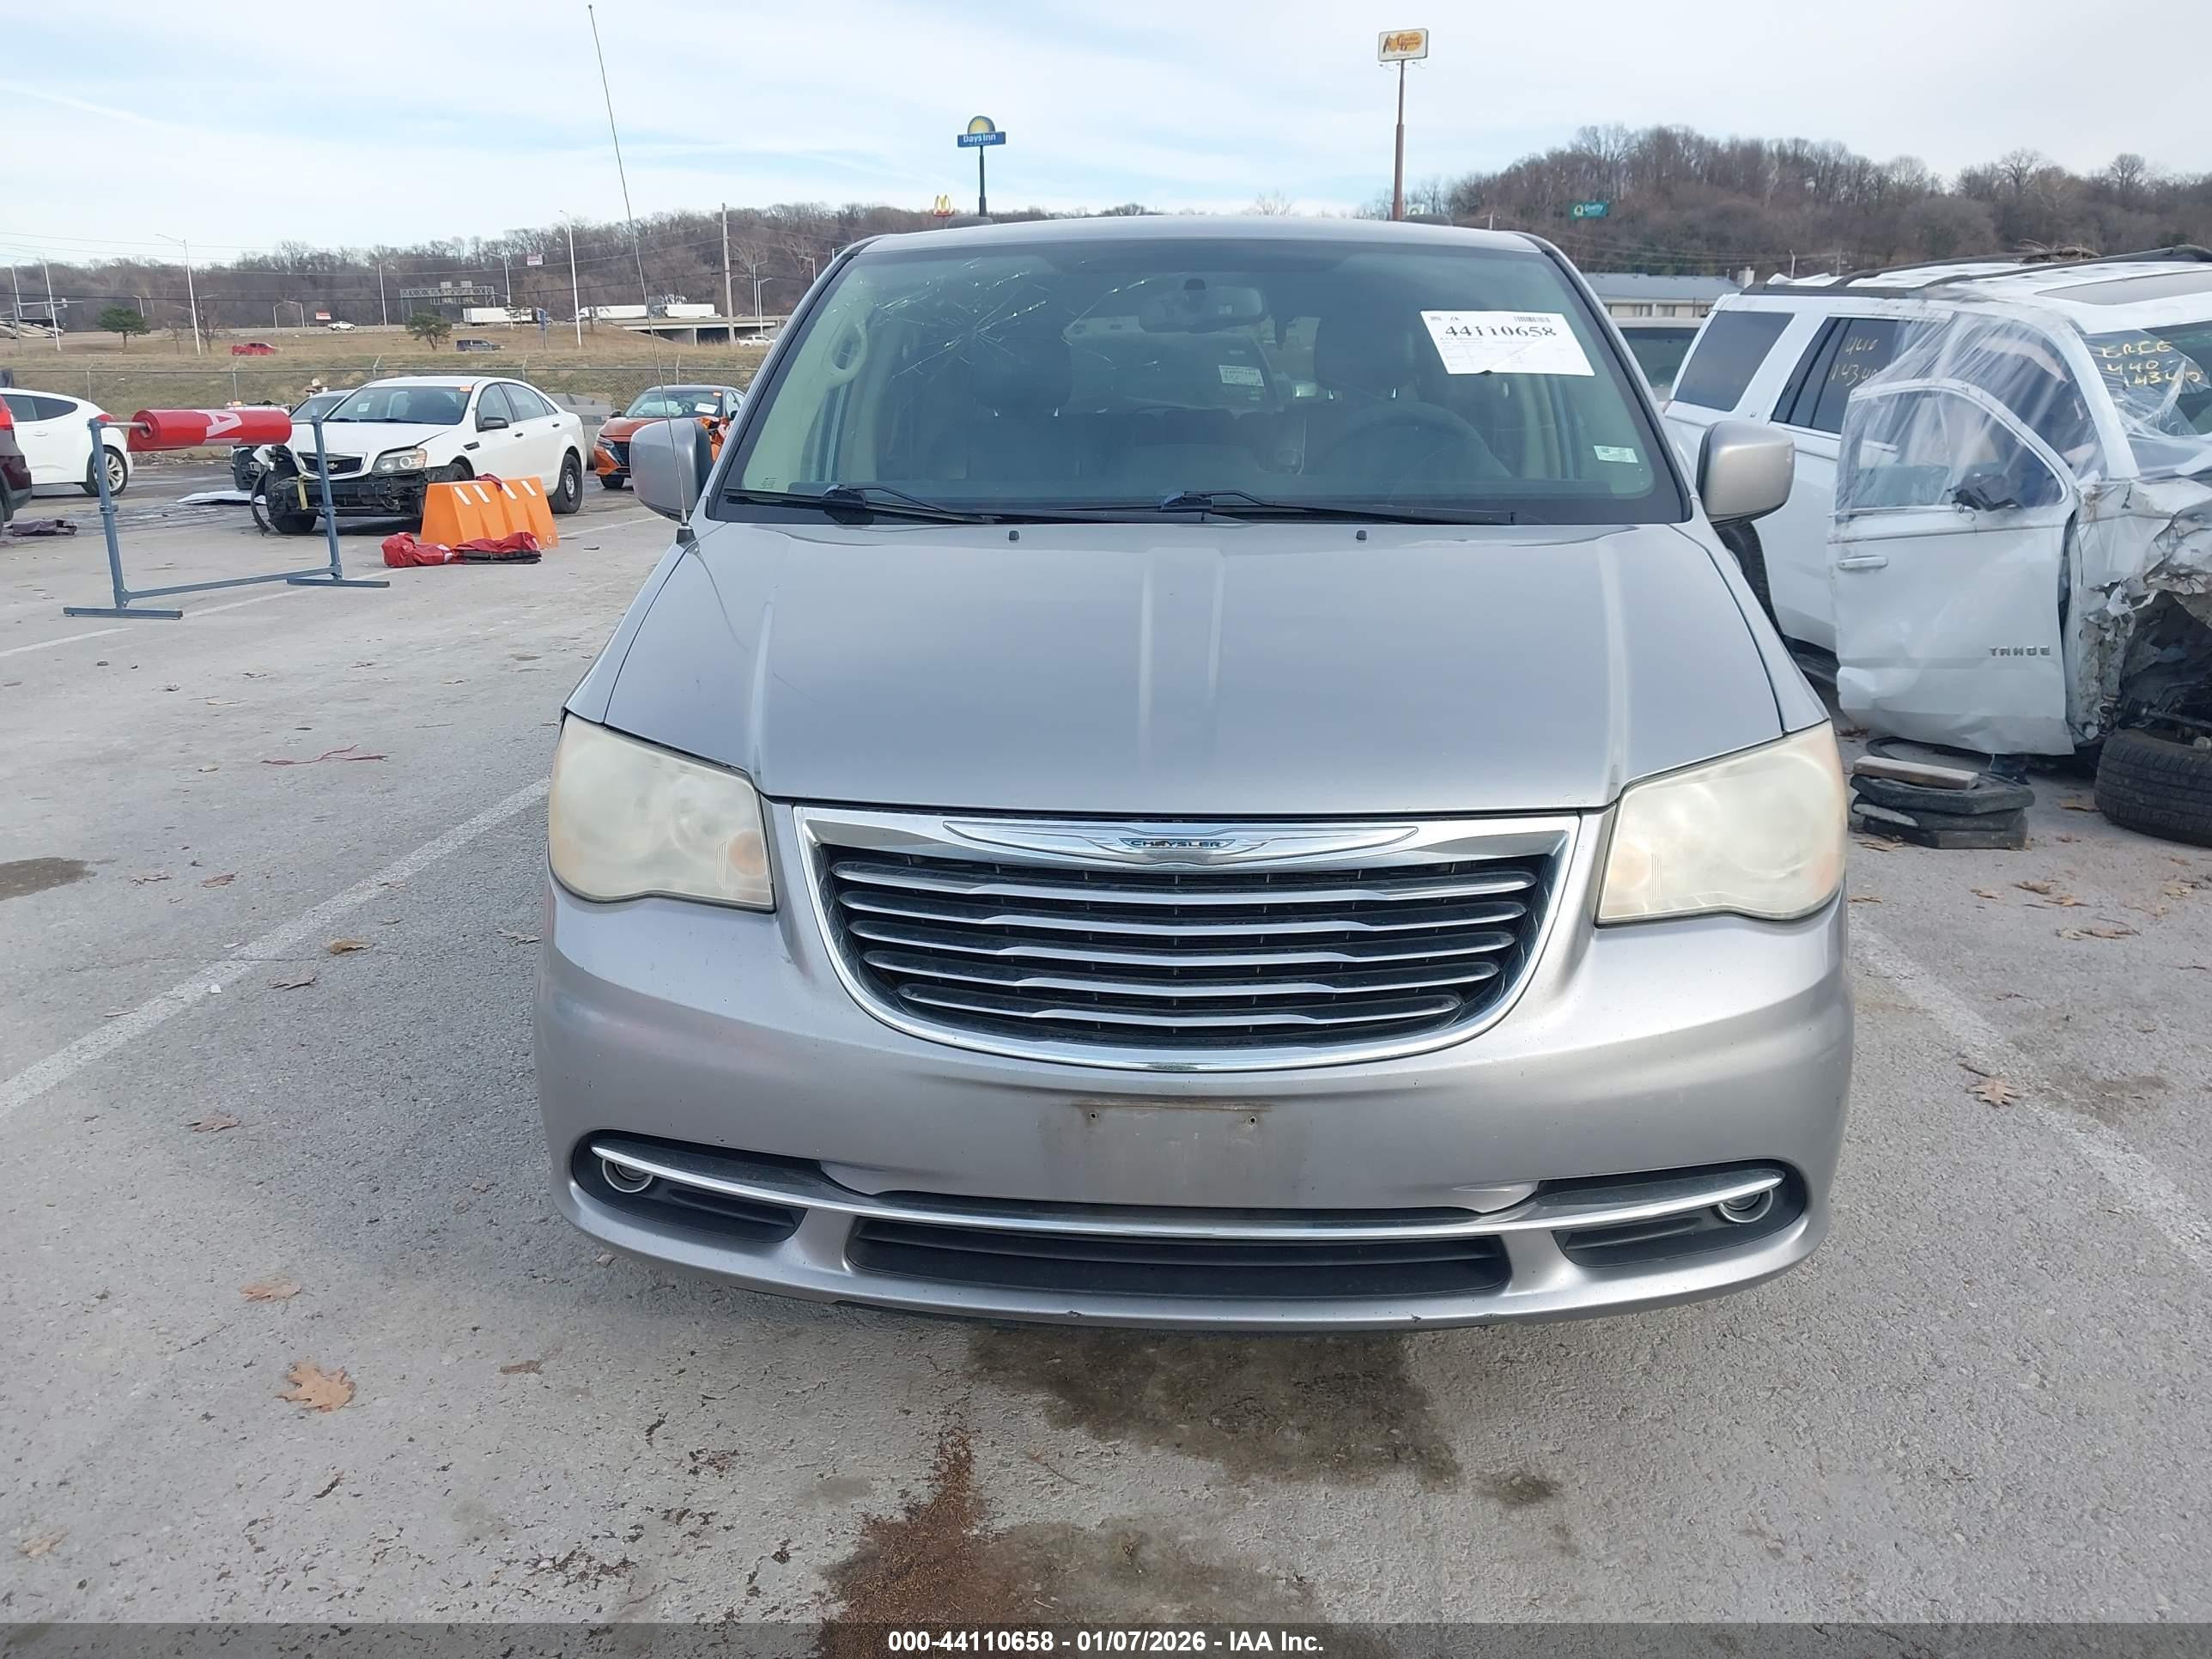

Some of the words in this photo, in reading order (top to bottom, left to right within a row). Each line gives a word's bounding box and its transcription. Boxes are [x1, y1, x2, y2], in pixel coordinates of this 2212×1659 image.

[963, 134, 982, 143] Days
[983, 133, 996, 142] Inn
[1445, 325, 1557, 337] 44110658
